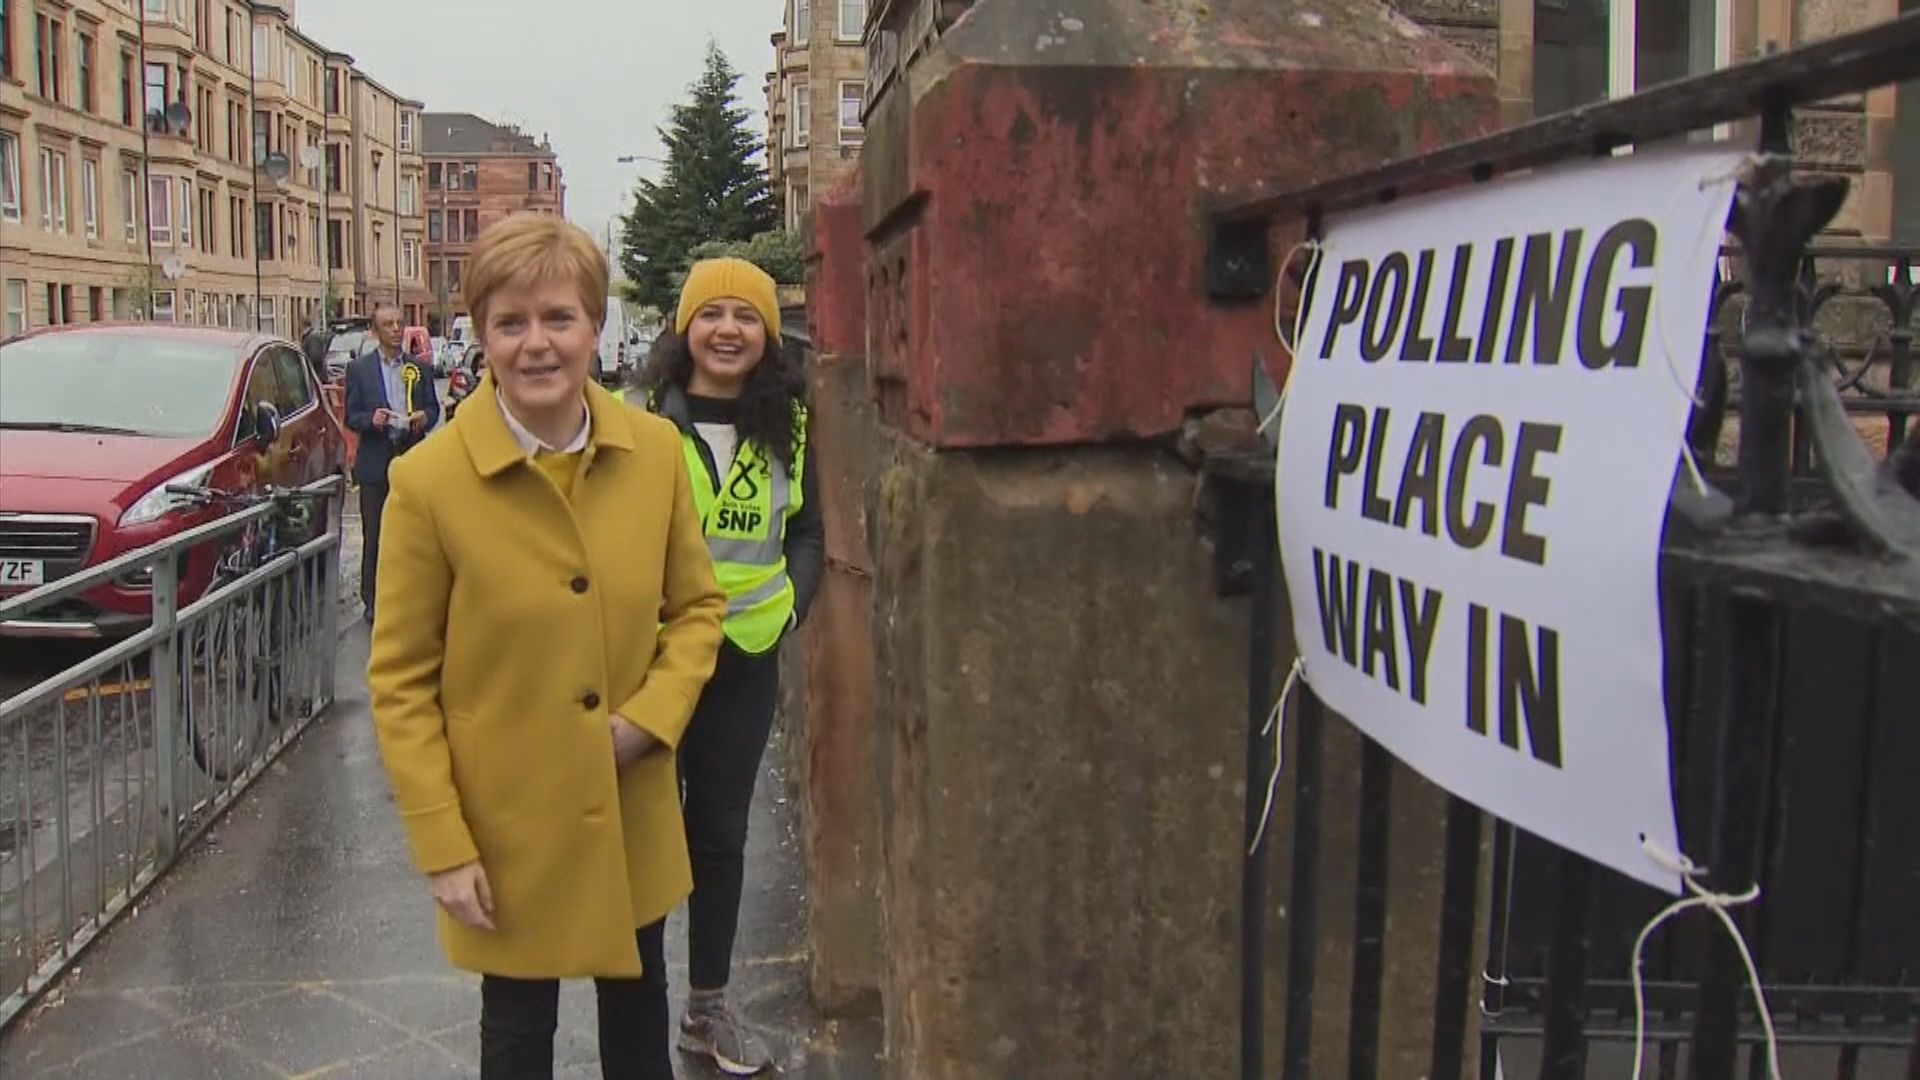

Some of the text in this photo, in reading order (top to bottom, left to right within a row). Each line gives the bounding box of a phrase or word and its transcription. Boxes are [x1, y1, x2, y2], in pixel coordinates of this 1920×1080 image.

[1320, 218, 1656, 370] POLLING
[718, 509, 761, 532] SNP
[1324, 403, 1563, 566] PLACE
[1312, 547, 1564, 769] WAY IN
